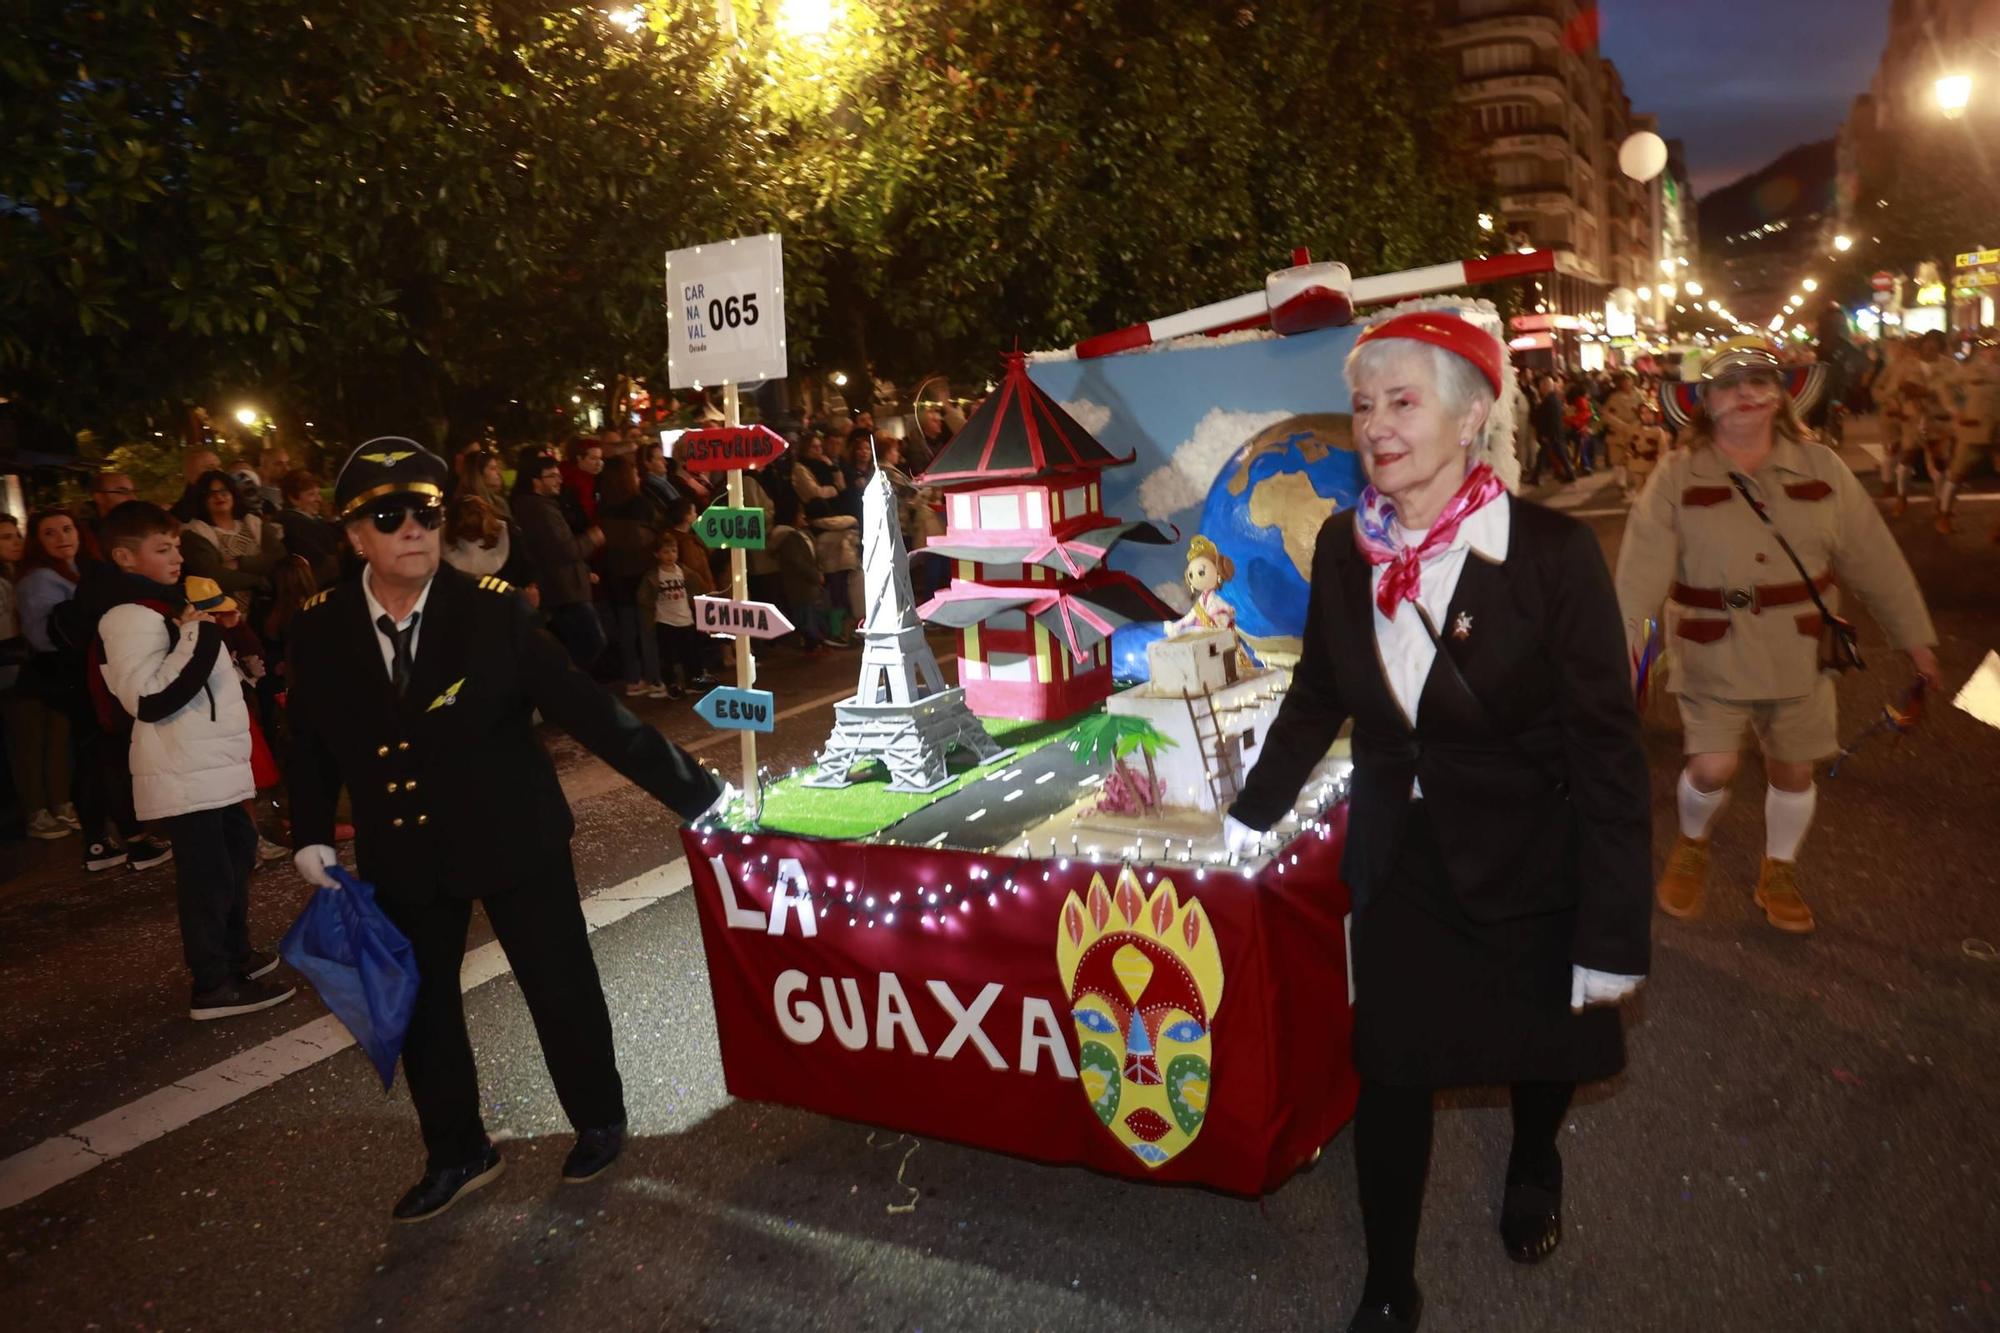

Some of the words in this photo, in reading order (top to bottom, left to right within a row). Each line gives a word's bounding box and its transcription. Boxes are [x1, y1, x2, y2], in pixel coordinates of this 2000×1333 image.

[685, 284, 705, 301] CAR
[687, 305, 700, 320] NA
[709, 293, 759, 331] 065
[688, 324, 706, 339] VAL
[687, 435, 773, 459] ASTURIAS
[706, 515, 761, 539] CUBA
[704, 601, 769, 630] CHINA
[715, 699, 767, 723] EEUU
[709, 857, 817, 938] LA
[773, 969, 1078, 1079] GUAXA
